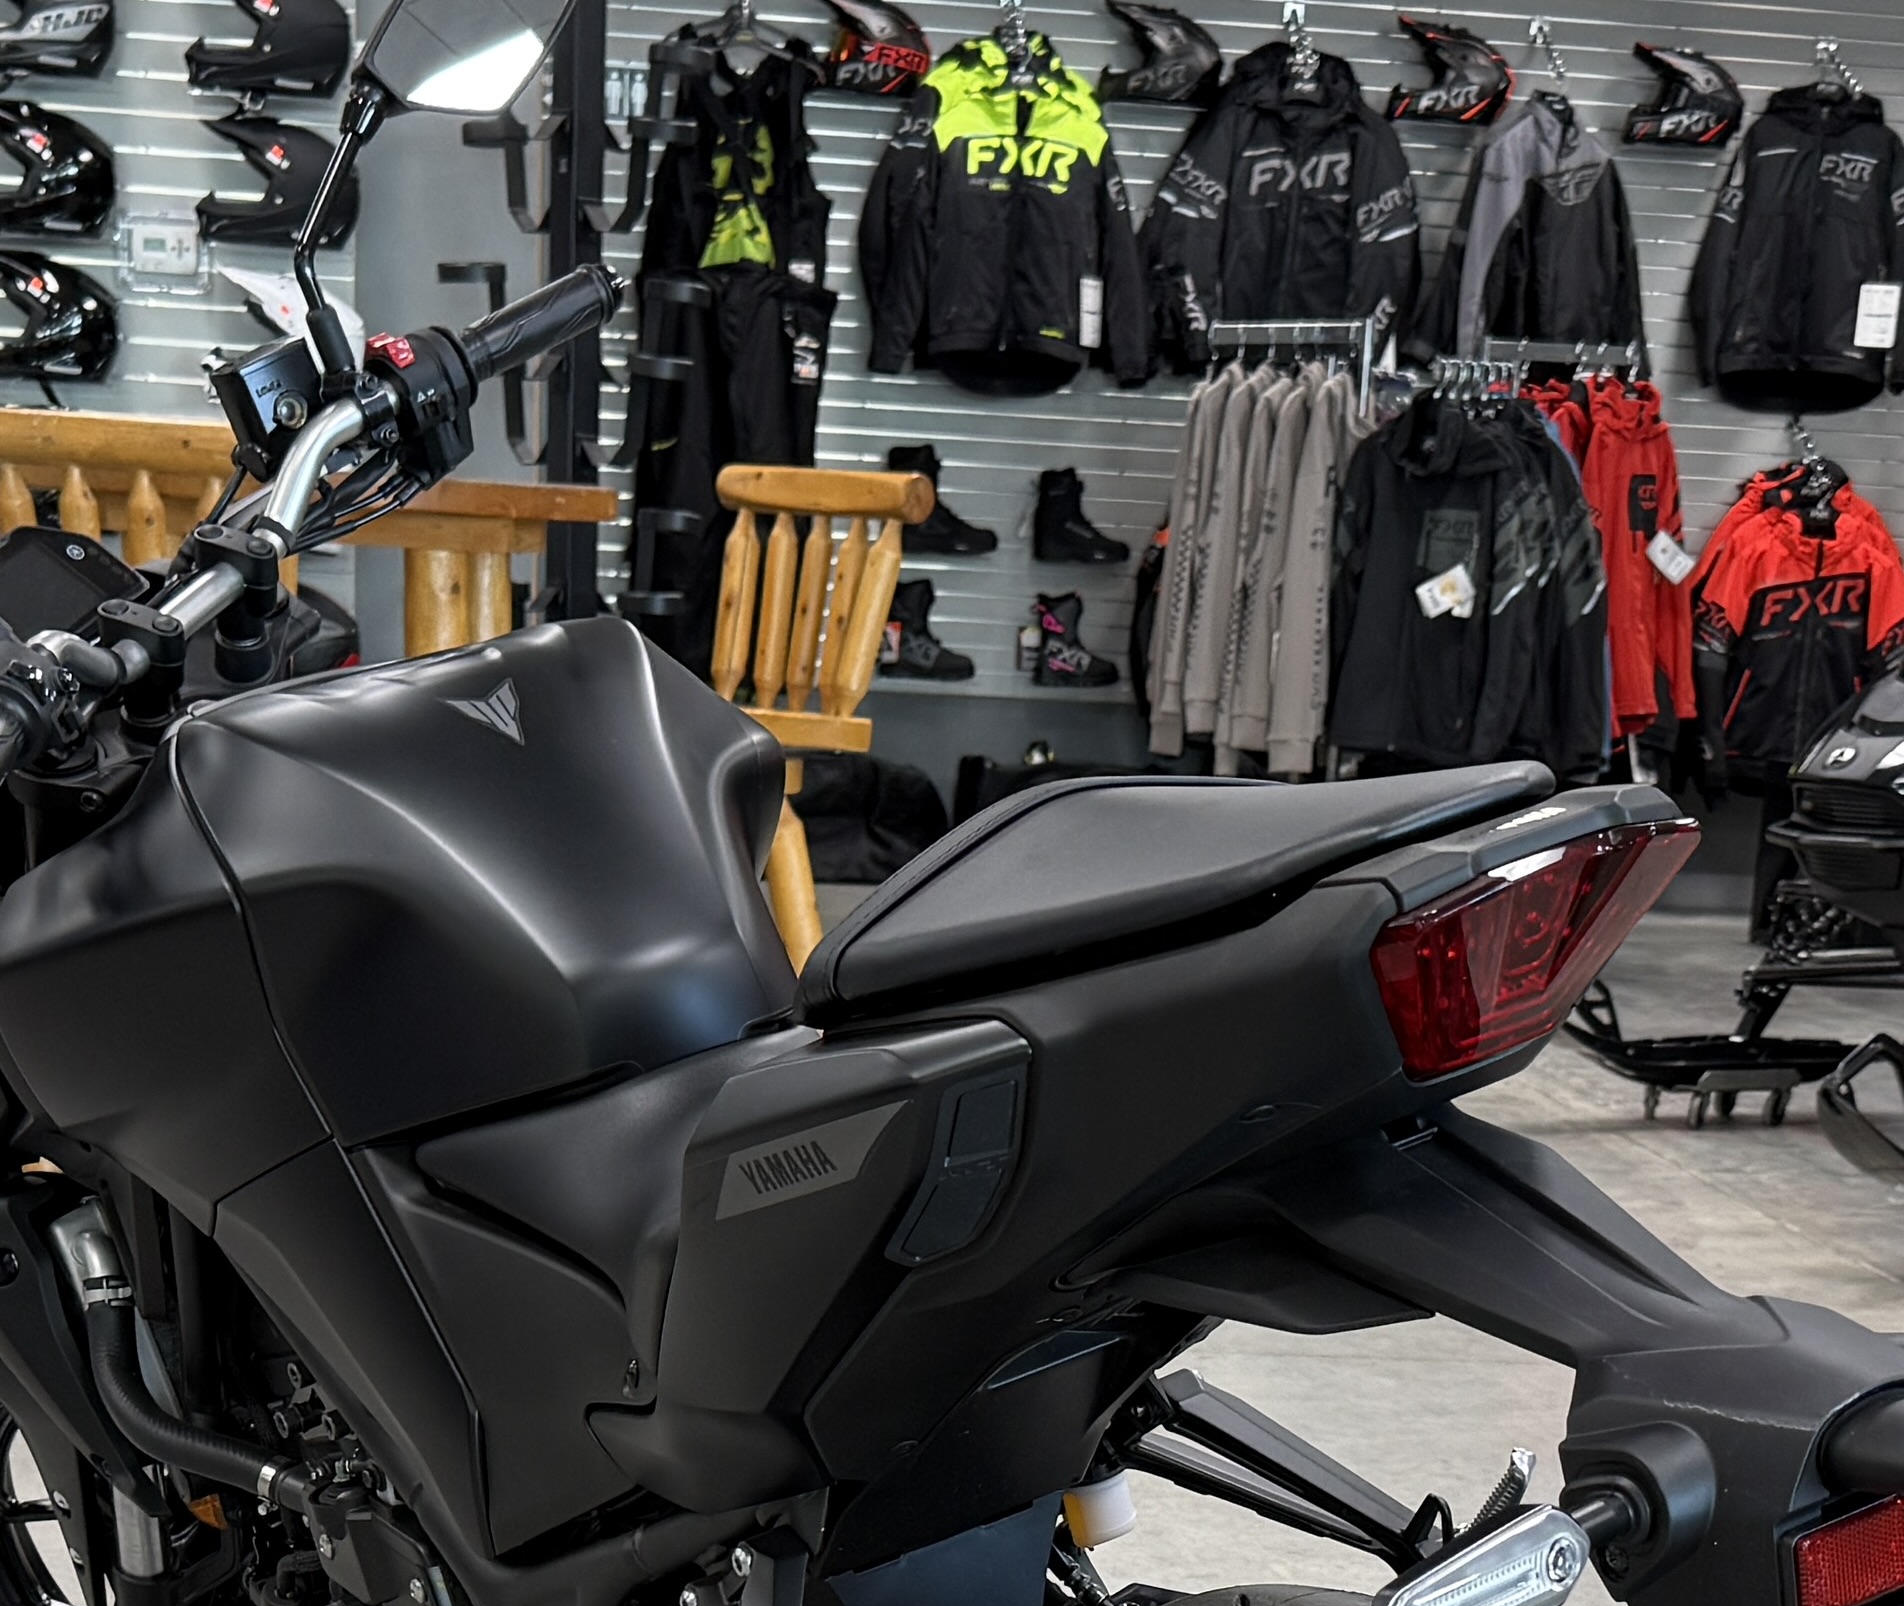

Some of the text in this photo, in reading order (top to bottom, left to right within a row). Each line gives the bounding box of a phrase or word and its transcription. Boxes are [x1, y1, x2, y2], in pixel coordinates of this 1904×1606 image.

[40, 7, 105, 33] HJC
[876, 45, 925, 69] FXR
[1418, 84, 1482, 115] FXR
[967, 137, 1079, 182] FXR
[1249, 151, 1352, 197] FXR
[1820, 154, 1879, 182] FXR
[1760, 578, 1866, 627] FXR
[738, 1141, 838, 1194] YAMAHA
